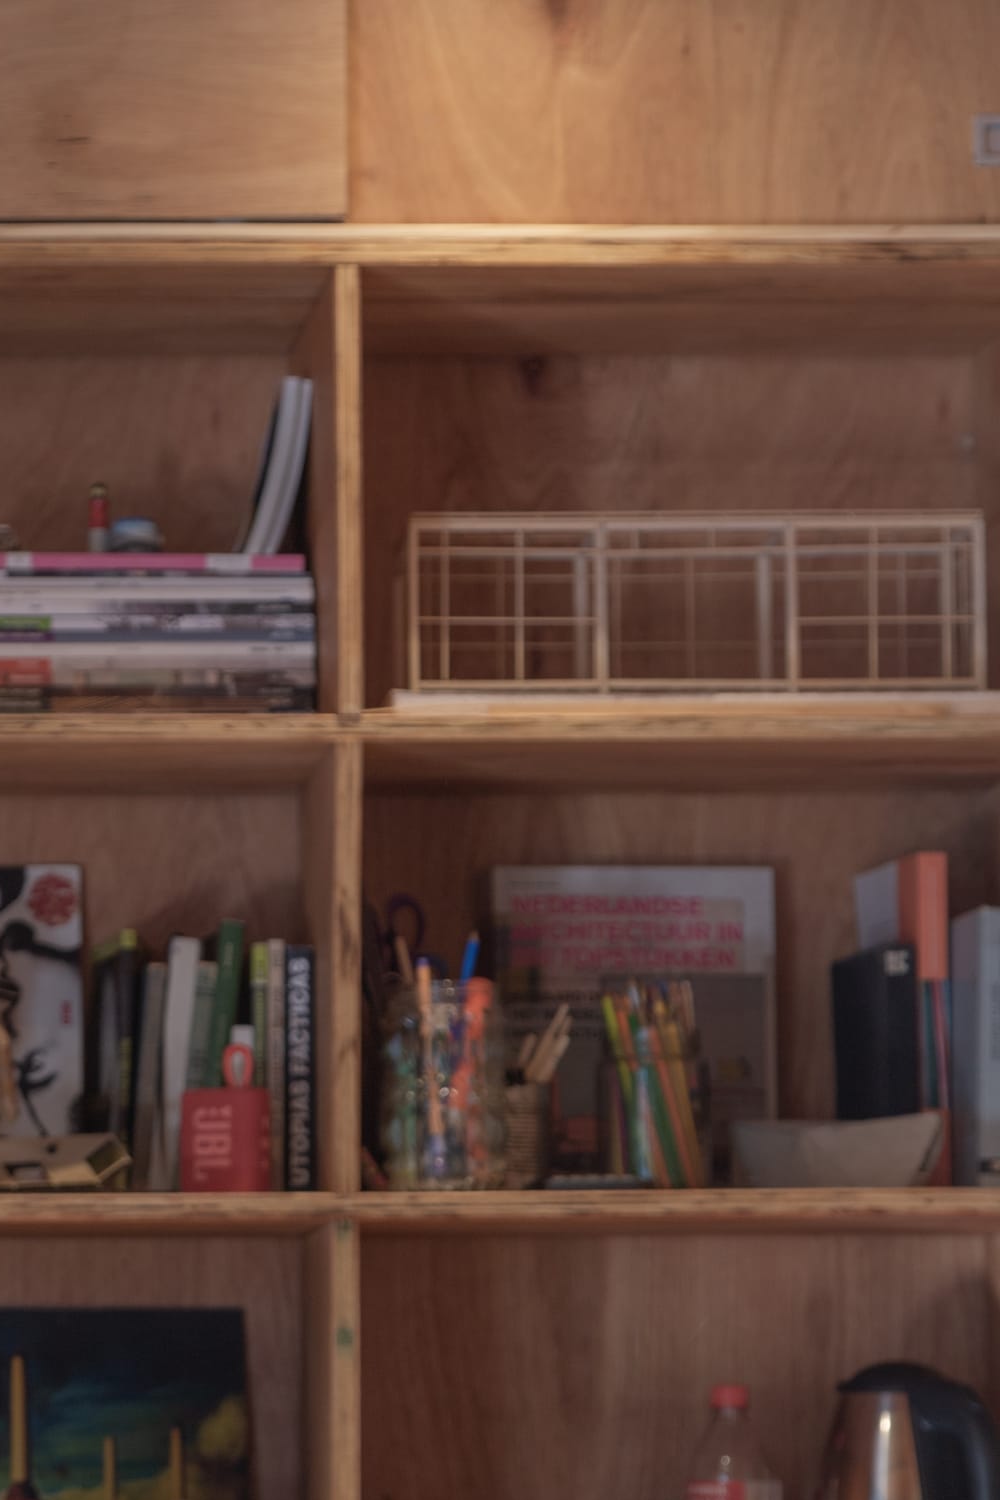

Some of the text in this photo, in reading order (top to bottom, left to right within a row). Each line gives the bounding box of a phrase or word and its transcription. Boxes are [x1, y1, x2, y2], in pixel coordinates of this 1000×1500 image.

[511, 896, 704, 915] NEDERLANDSE
[718, 921, 744, 942] IN
[288, 957, 311, 1186] UTOPIAS FACTICAS
[192, 1104, 233, 1181] JBL
